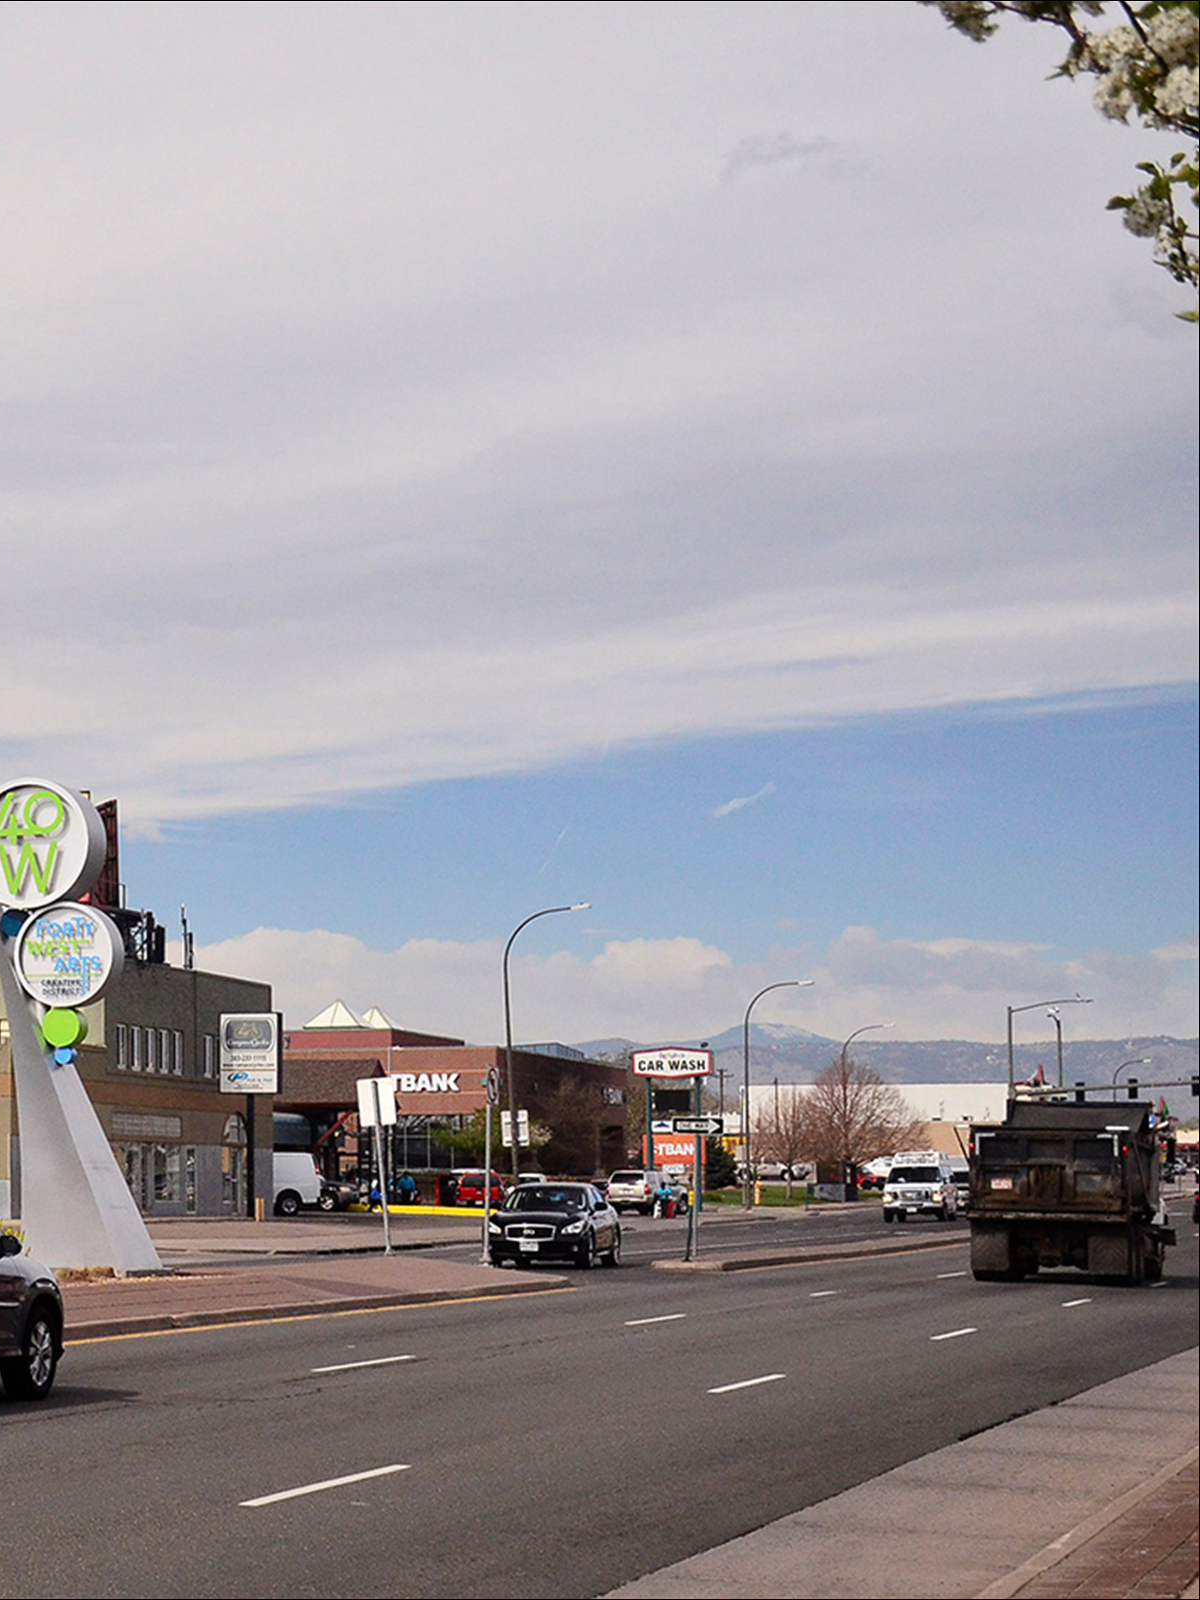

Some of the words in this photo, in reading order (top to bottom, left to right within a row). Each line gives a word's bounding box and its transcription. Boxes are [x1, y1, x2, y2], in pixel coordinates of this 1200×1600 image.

[36, 916, 94, 938] FORTY
[25, 938, 91, 957] WEST
[40, 979, 81, 988] CREATIVE
[53, 955, 102, 996] ARTS
[638, 1060, 664, 1071] CAR
[668, 1060, 706, 1071] WASH
[390, 1073, 460, 1092] TBANK
[694, 1121, 709, 1130] WAY
